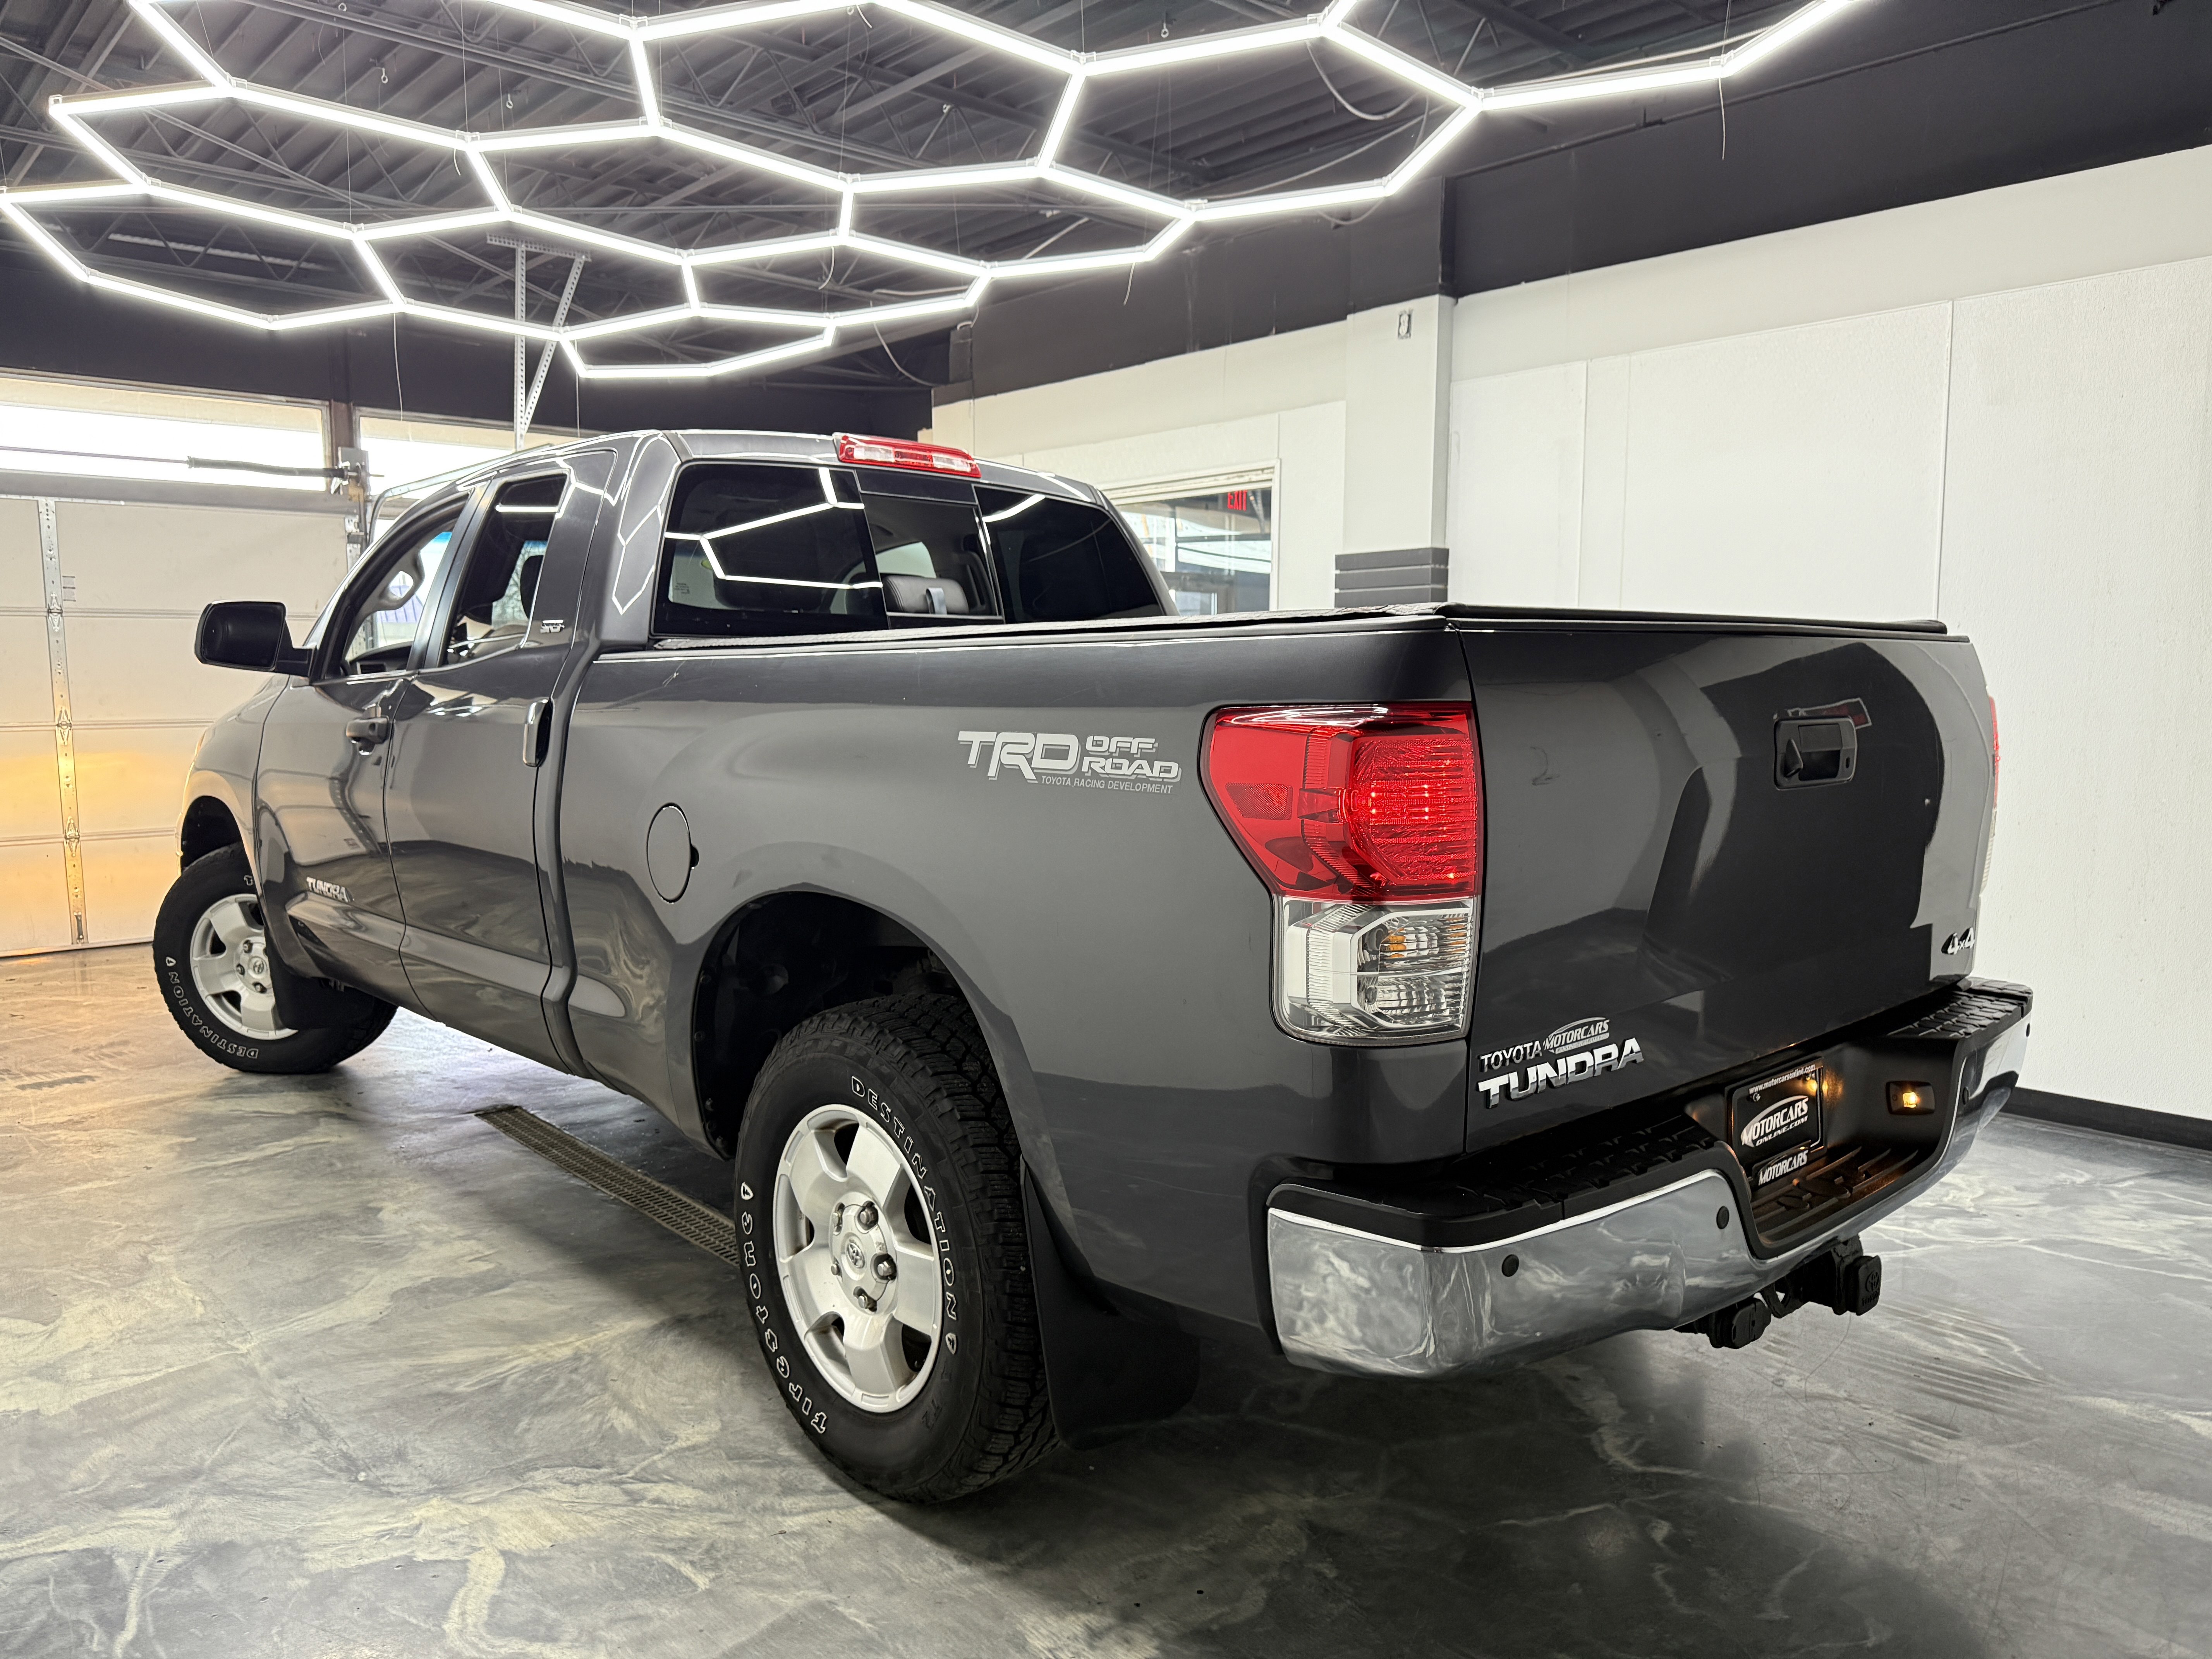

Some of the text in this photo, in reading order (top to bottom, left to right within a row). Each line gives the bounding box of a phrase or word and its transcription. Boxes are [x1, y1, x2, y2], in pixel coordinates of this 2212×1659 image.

[958, 731, 1080, 782] TRD
[1085, 736, 1157, 756] OFF
[1082, 757, 1181, 781] ROAD
[1041, 776, 1173, 794] TOYOTA RACING DEVELOPMENT
[306, 877, 350, 903] TUNDRA
[168, 971, 259, 1059] DESTINATION
[1543, 1019, 1610, 1051] MOTORCARS
[1480, 1041, 1543, 1072] TOYOTA
[1477, 1037, 1644, 1109] TUNDRA
[1749, 1064, 1815, 1094] www.motorcarsonline.com
[1741, 1097, 1809, 1146] MOTORCARS
[1755, 1116, 1808, 1146] ONLINE.COM
[1758, 1150, 1809, 1186] MOTORCARS
[852, 1076, 957, 1321] DESTINATION
